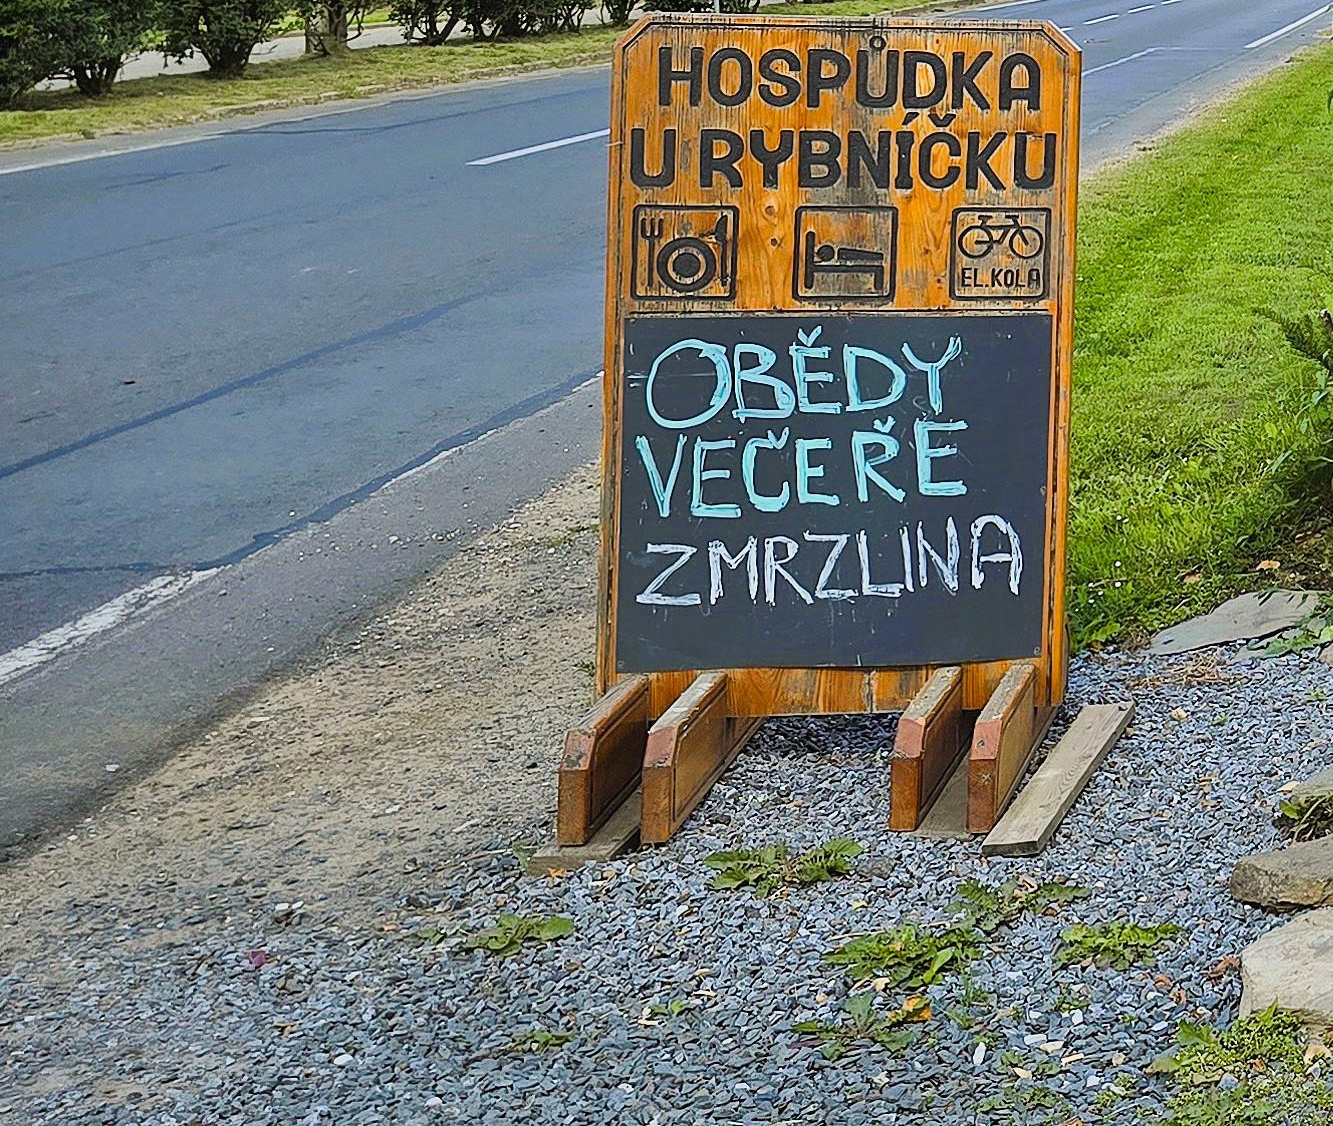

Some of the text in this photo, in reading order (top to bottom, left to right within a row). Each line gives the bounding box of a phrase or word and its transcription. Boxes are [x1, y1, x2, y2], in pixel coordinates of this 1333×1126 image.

[658, 35, 1041, 111] HOSPŮDKA
[630, 113, 1058, 191] U RYBNÍČKU
[646, 326, 962, 430] OBĚDY
[635, 415, 968, 519] VEČEŘE
[635, 514, 1024, 607] ZMRZLINA
